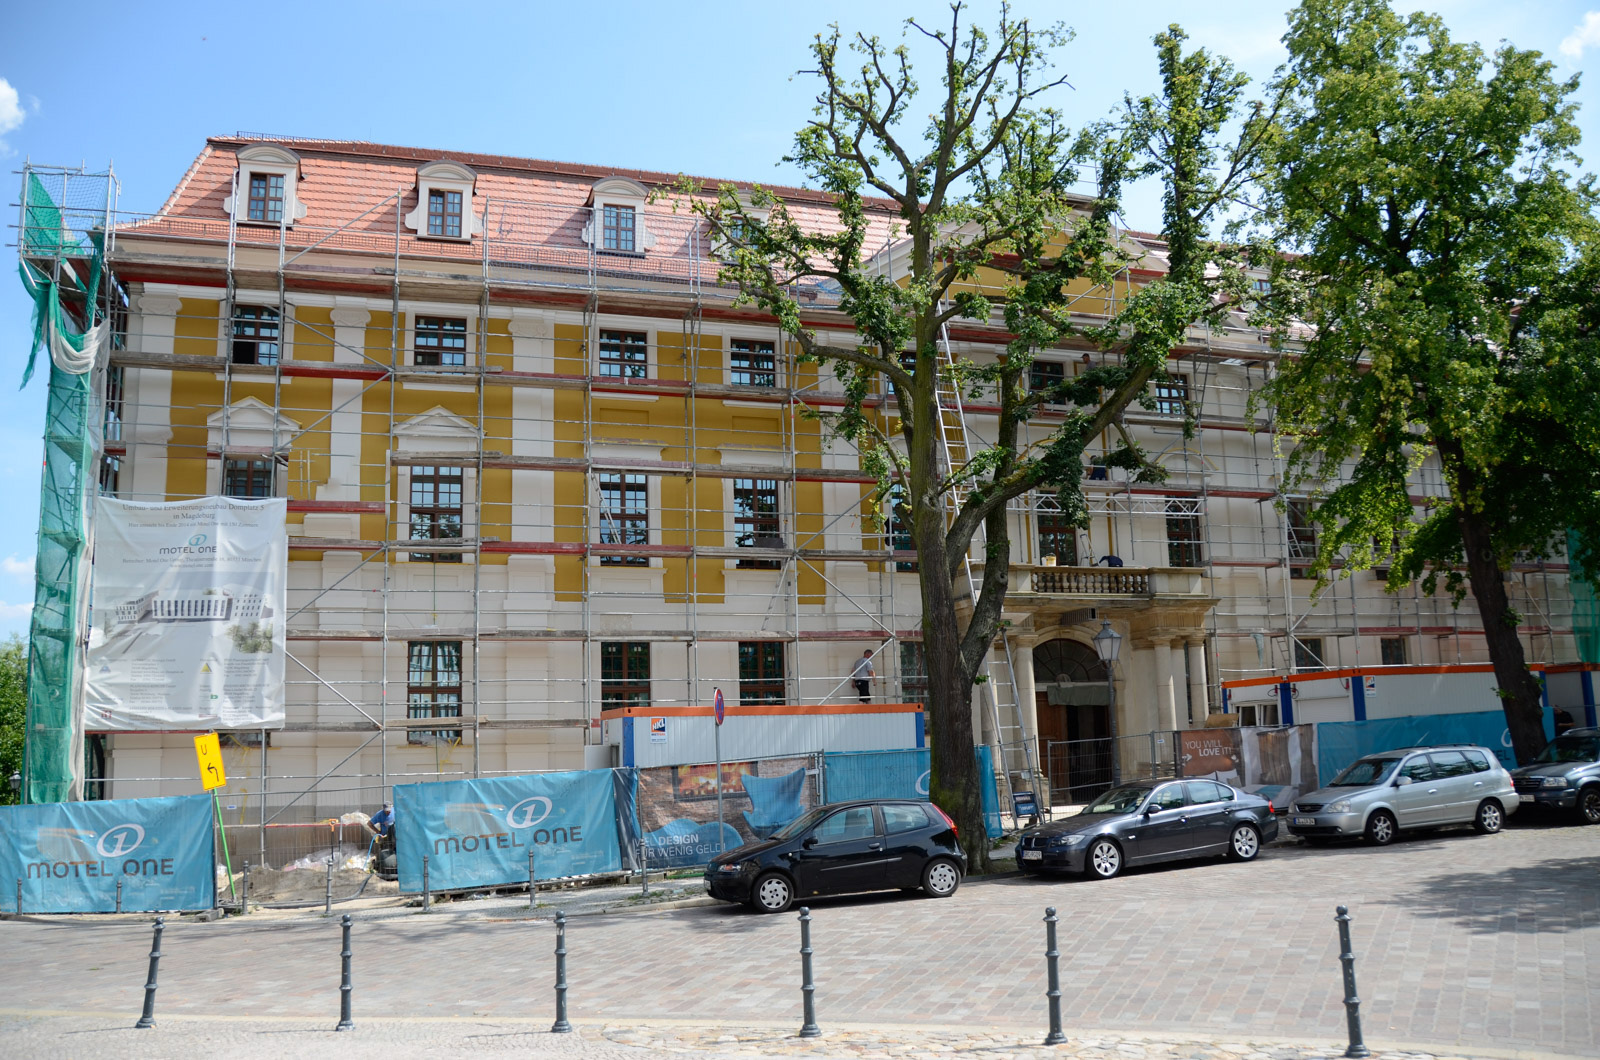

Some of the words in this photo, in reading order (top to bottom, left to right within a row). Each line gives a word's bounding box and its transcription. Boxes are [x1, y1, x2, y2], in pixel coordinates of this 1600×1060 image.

[228, 504, 258, 512] Domplatz
[181, 513, 215, 521] Magdeburg
[159, 546, 195, 555] MOTEL
[198, 546, 217, 554] ONE
[1185, 740, 1202, 749] YOU
[1203, 739, 1222, 748] WILL
[200, 744, 208, 756] U
[1199, 747, 1221, 757] LOVE
[1221, 746, 1232, 755] IT!
[434, 832, 525, 856] MOTEL
[533, 825, 583, 846] ONE
[634, 836, 656, 848] VEL
[658, 834, 699, 846] DESIGN
[635, 846, 655, 858] FR
[657, 846, 693, 857] WENIG
[27, 860, 113, 879] MOTEL
[122, 858, 175, 876] ONE
